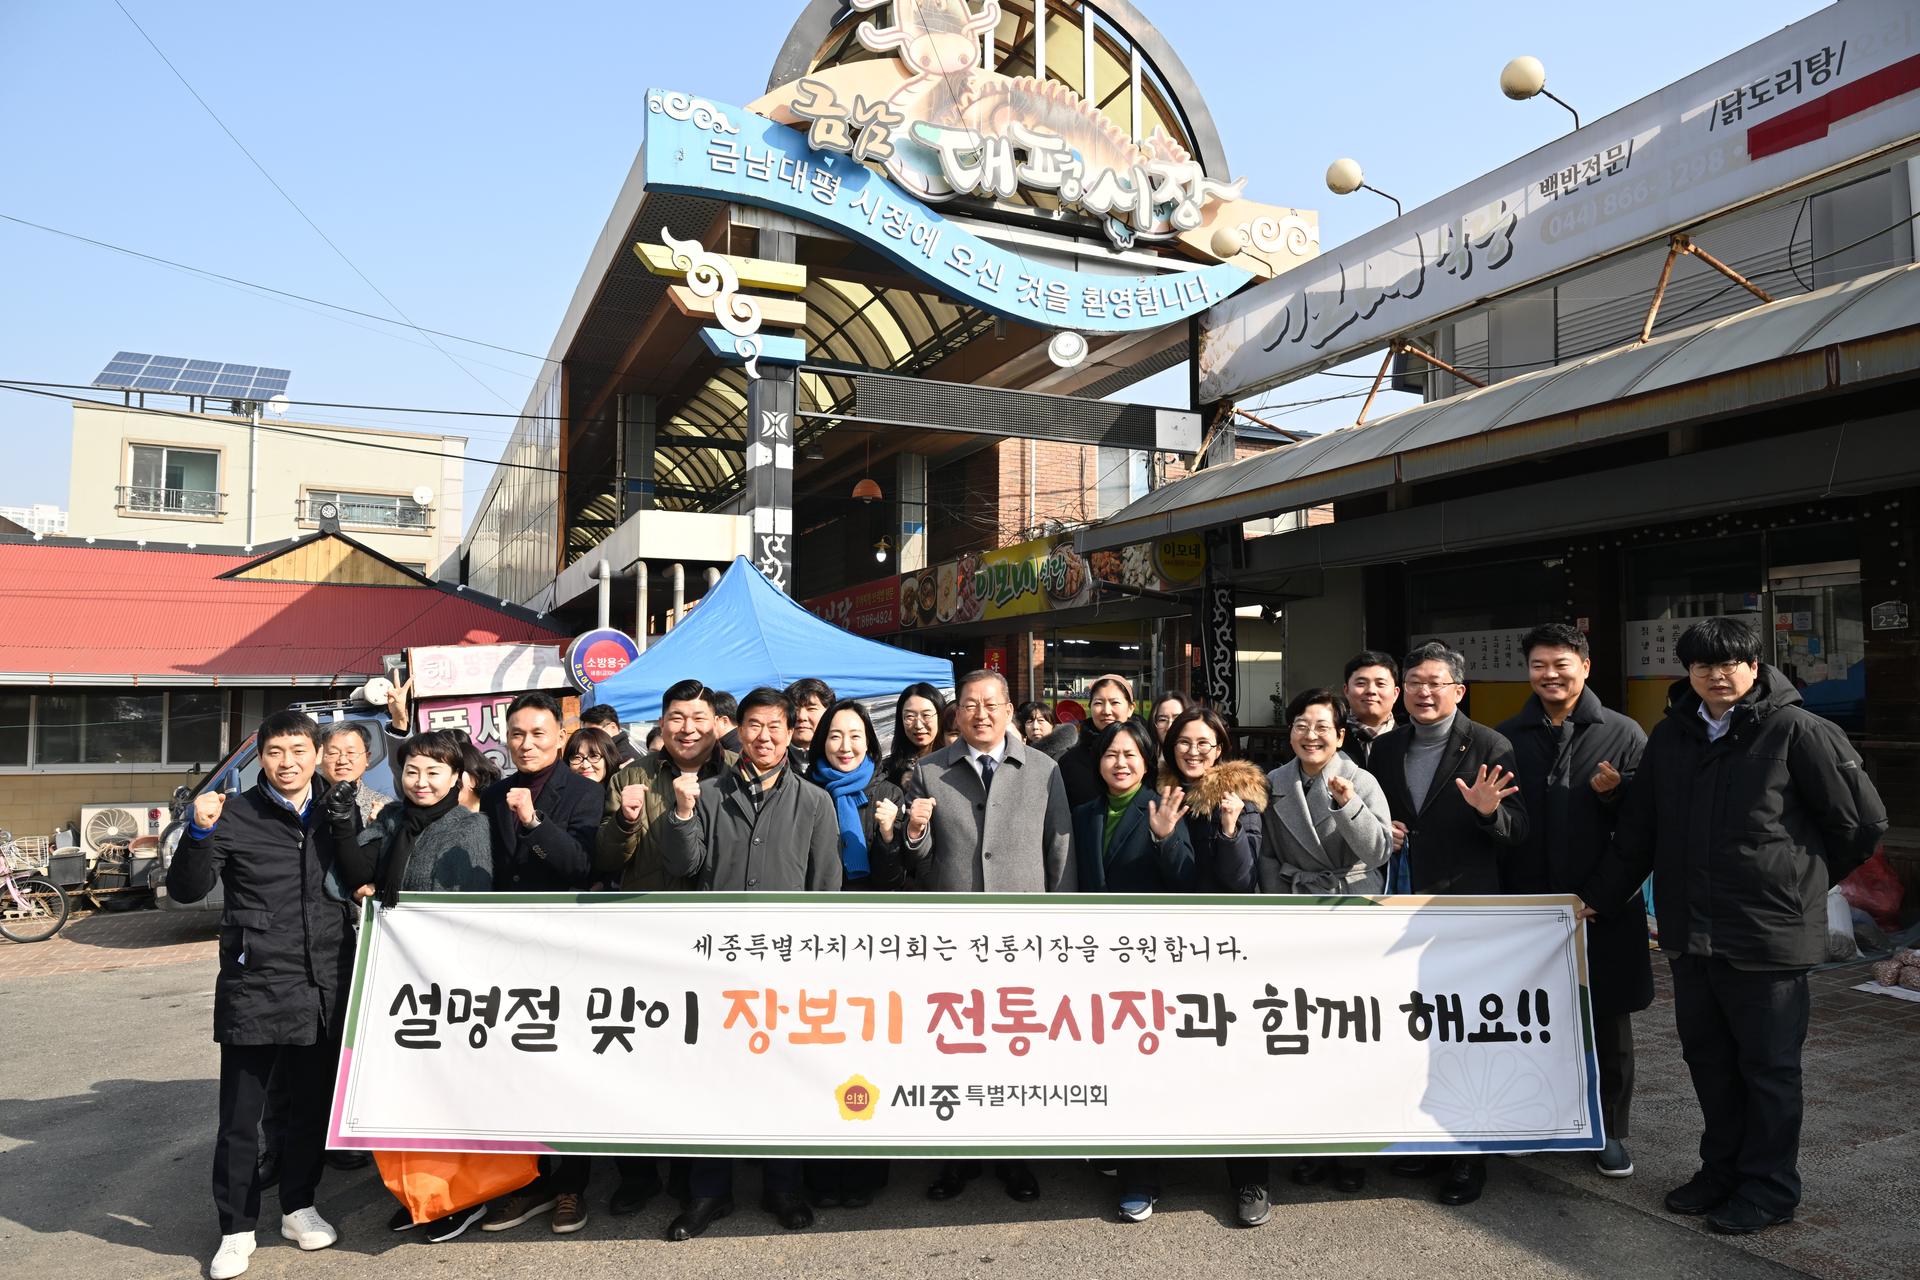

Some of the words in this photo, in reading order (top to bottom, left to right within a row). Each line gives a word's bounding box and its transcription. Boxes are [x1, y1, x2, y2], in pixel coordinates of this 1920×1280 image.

[792, 78, 904, 160] 금남
[909, 120, 1247, 231] 대평시장
[707, 138, 842, 205] 금남대평
[851, 188, 943, 259] 시장에
[945, 244, 1005, 293] 오신
[1017, 274, 1071, 314] 것을
[1082, 275, 1224, 318] 환영합니다.
[1163, 542, 1201, 560] 이모네
[975, 558, 1038, 608] 이모네
[586, 657, 627, 669] 소방용수
[693, 933, 957, 962] 세종특별자치시의회는
[969, 934, 1100, 963] 전통시장을
[1109, 935, 1248, 963] 응원합니다.
[389, 983, 560, 1054] 설명절
[586, 986, 699, 1055] 맞이
[722, 988, 903, 1055] 장보기
[927, 987, 1237, 1057] 전통시장과
[1253, 983, 1381, 1056] 함께
[1399, 988, 1551, 1044] 해요!!
[845, 1092, 868, 1106] 의회
